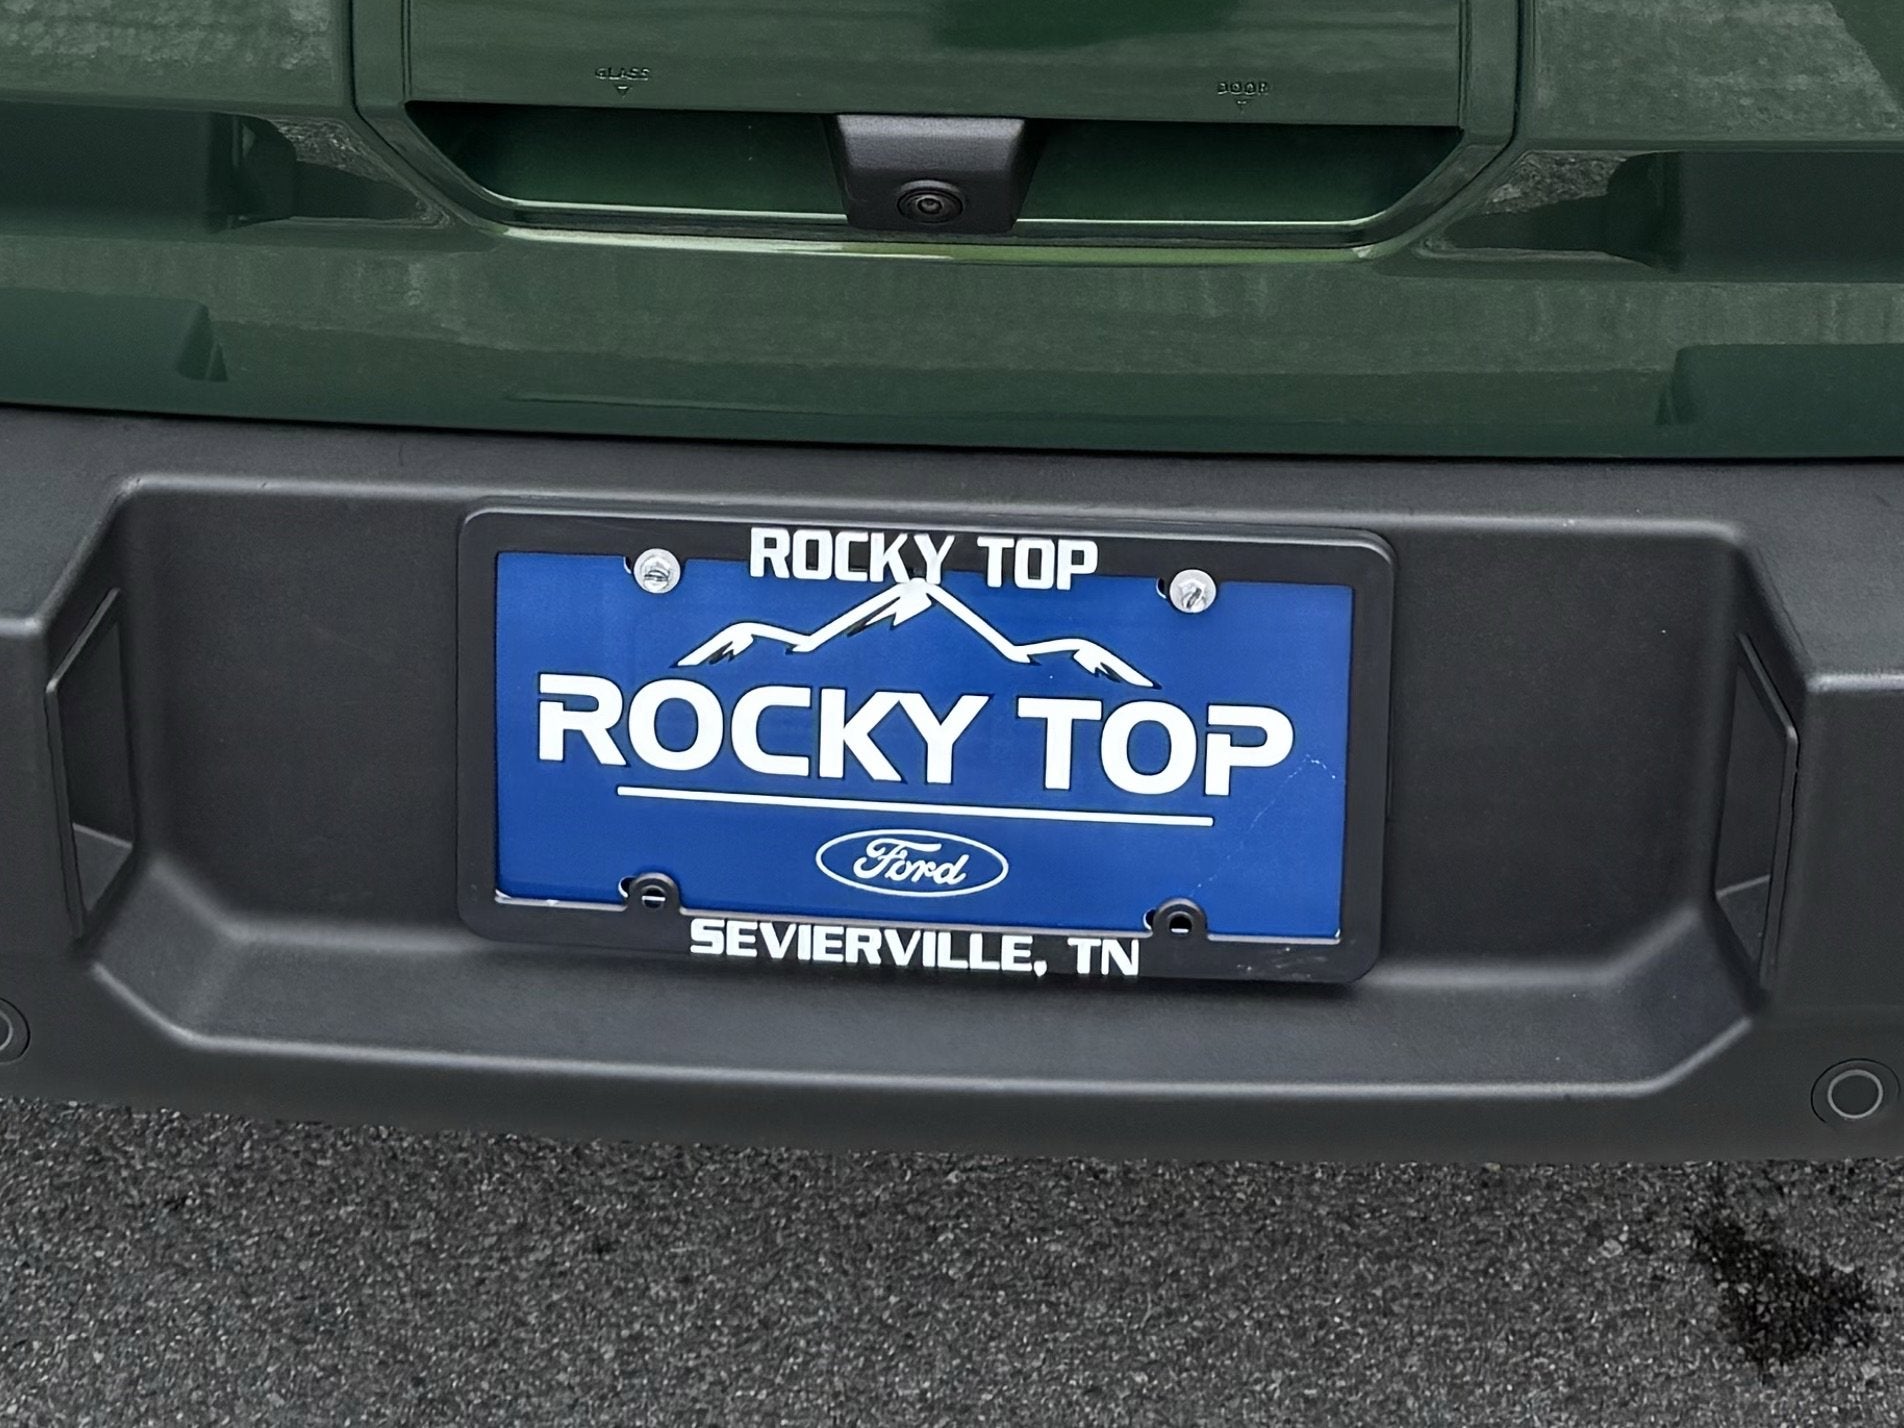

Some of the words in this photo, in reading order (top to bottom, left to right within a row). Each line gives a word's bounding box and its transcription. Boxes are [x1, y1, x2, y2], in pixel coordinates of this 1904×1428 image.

[750, 527, 955, 584] ROCKY
[976, 535, 1100, 590] TOP
[536, 672, 989, 784] ROCKY
[1018, 699, 1293, 796] TOP
[853, 838, 967, 886] Ford
[690, 919, 1049, 976] SEVIERVILLE,
[1067, 936, 1140, 975] TN
